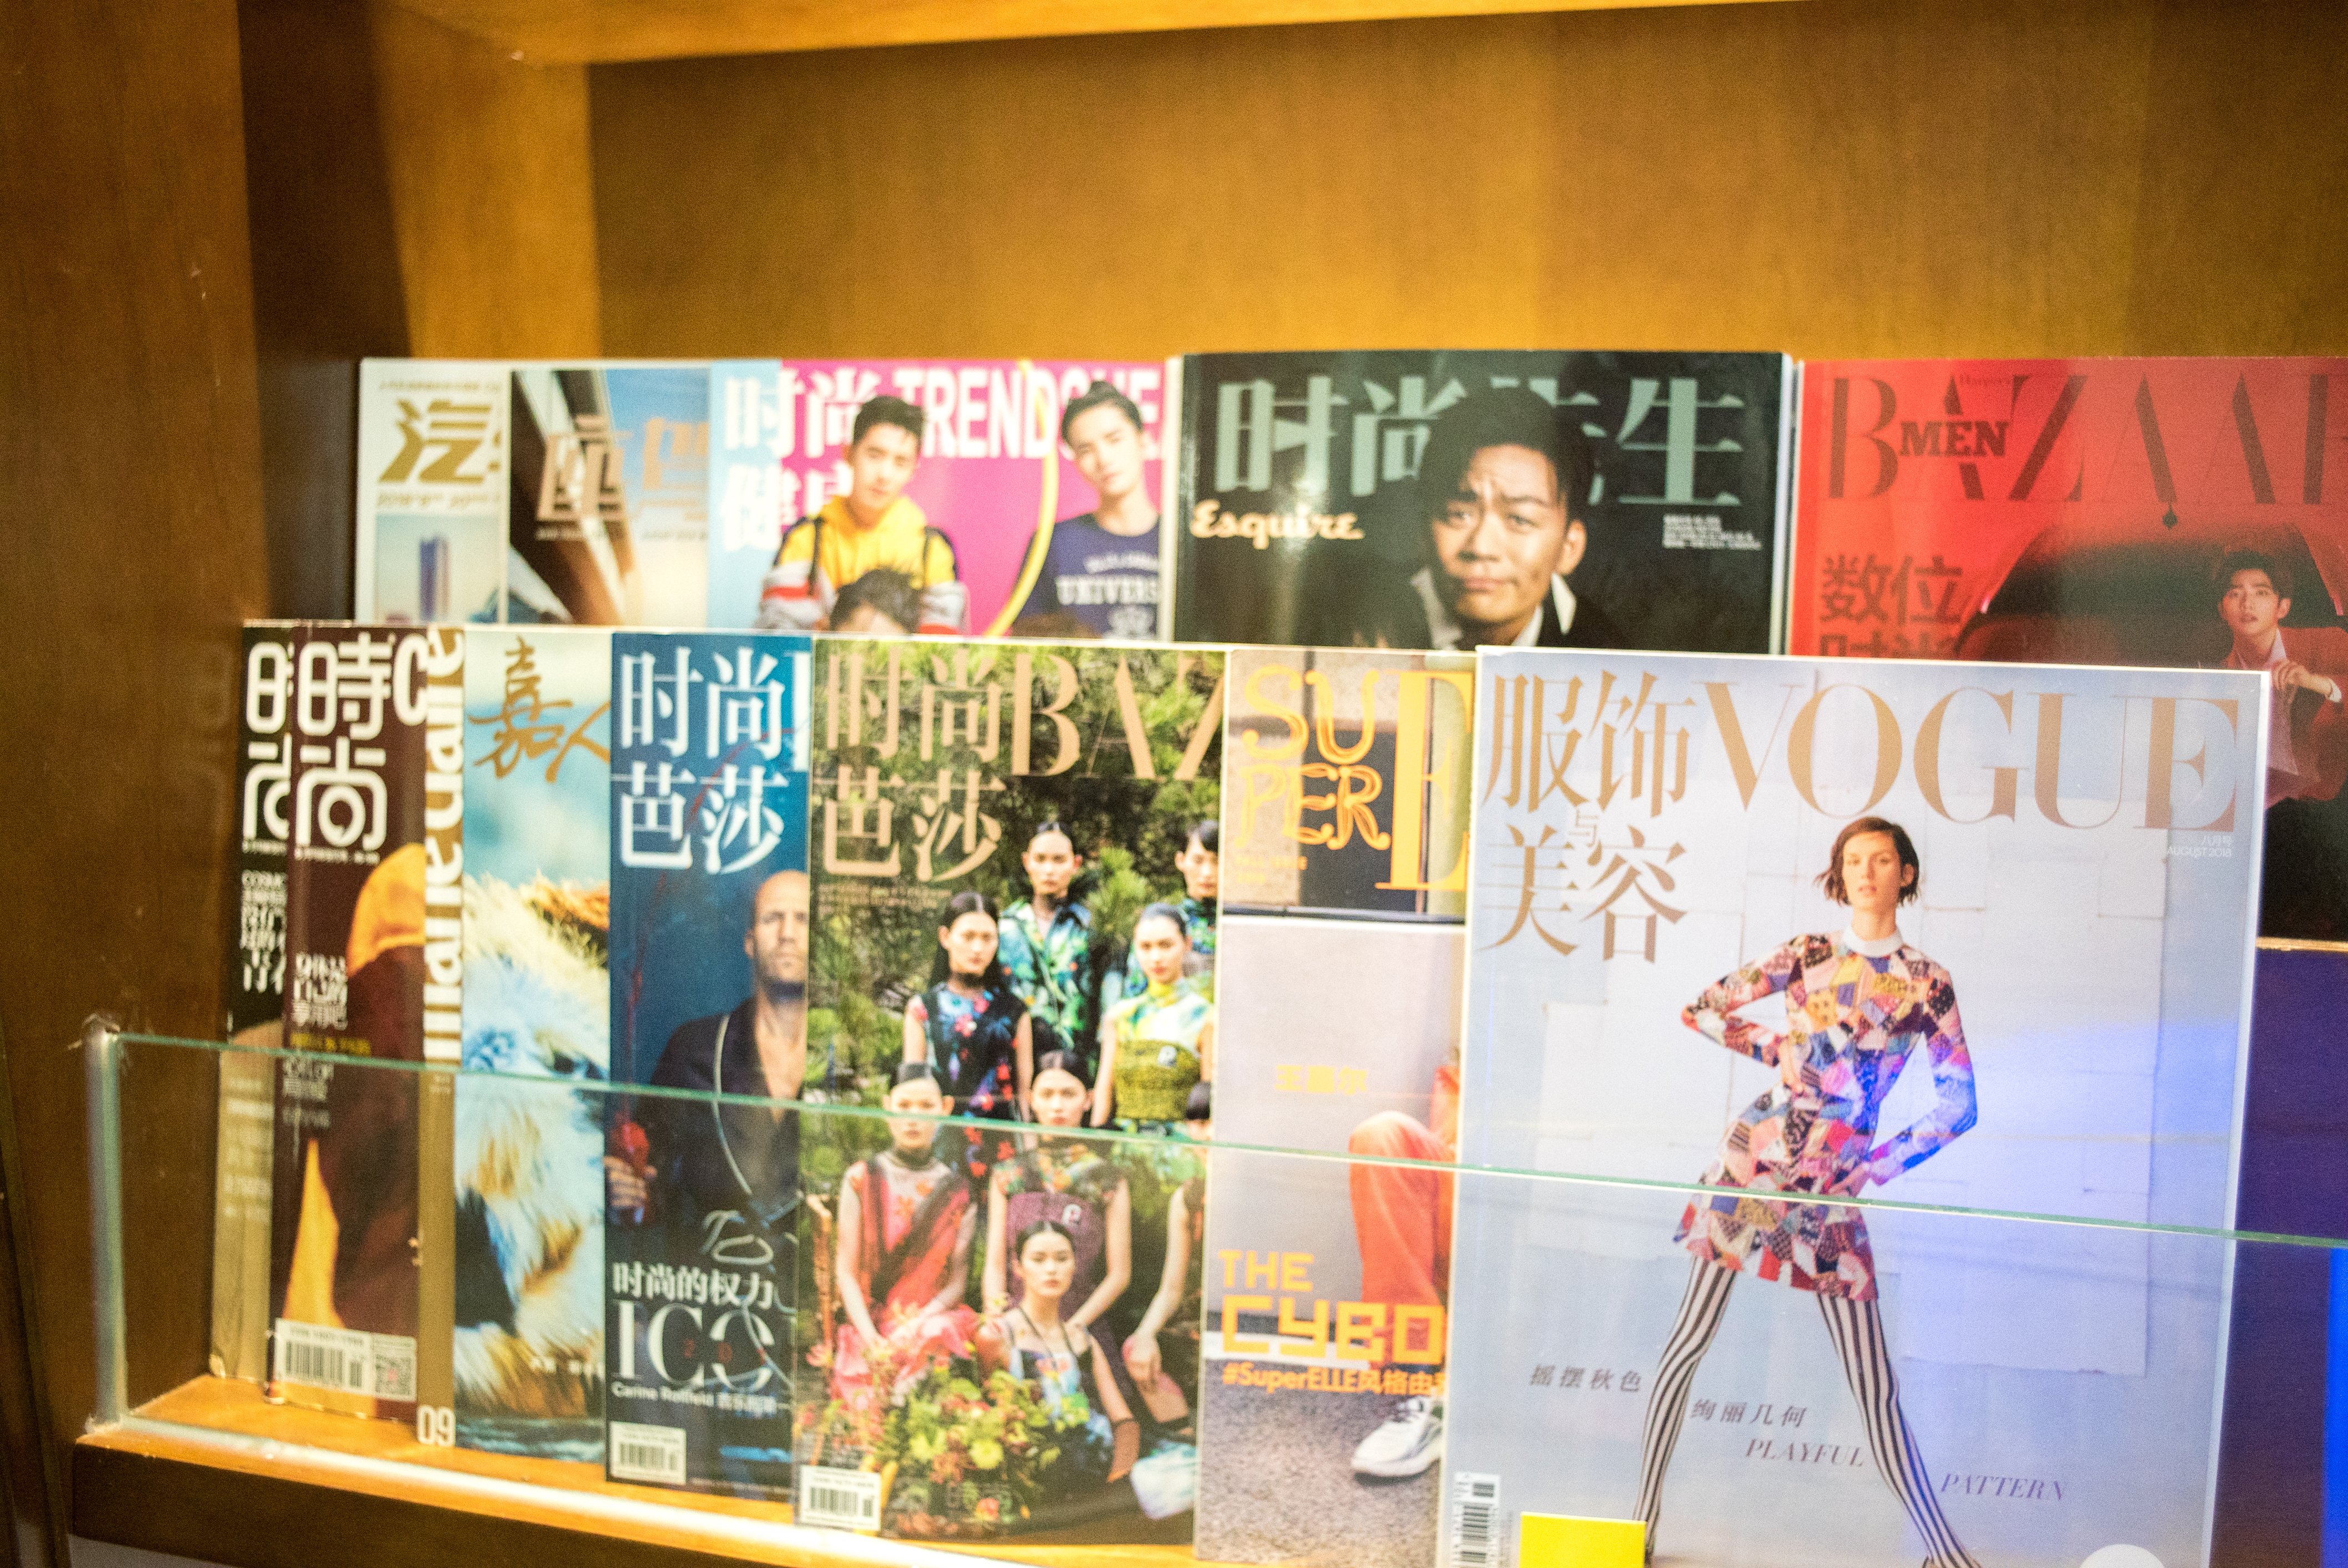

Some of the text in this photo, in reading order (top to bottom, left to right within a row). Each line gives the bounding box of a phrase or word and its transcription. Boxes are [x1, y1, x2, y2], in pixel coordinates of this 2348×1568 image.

[724, 366, 882, 457] 时尚
[893, 366, 1161, 461] TRENDE
[1898, 419, 2010, 458] MEN
[1189, 499, 1366, 551] Esquire
[1818, 554, 1966, 626] 数位
[620, 646, 785, 760] 时尚
[826, 646, 1003, 763] 时尚
[1241, 663, 1381, 765] SU
[1481, 669, 1697, 819] 服饰
[1691, 680, 2239, 833] VOGUE
[611, 761, 790, 875] 芭莎
[813, 764, 1007, 883] 芭莎
[1234, 762, 1391, 850] PER
[1475, 823, 1688, 964] 美容
[612, 1260, 775, 1310] 时尚的权力
[1217, 1249, 1315, 1292] THE
[611, 1299, 797, 1392] ICO
[1221, 1294, 1446, 1365] CYBO
[417, 1404, 456, 1447] 09
[1689, 1397, 1809, 1429] 绚丽几何
[1745, 1438, 1865, 1468] PLAYFUL
[1940, 1472, 2066, 1502] PATTERN
